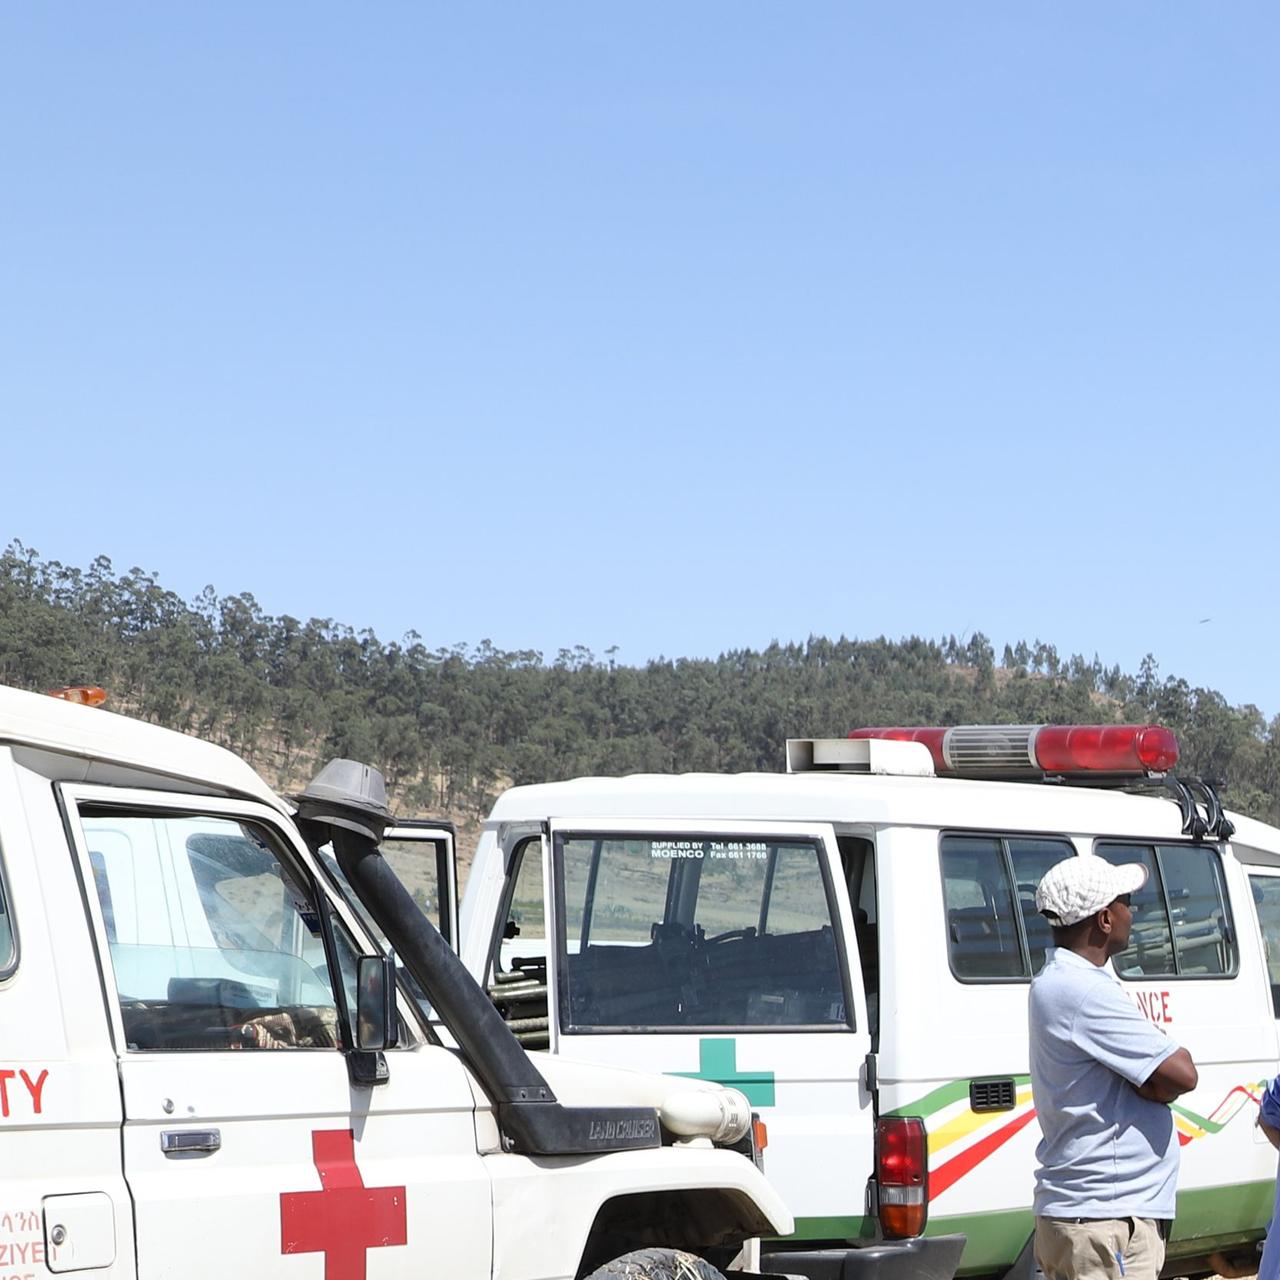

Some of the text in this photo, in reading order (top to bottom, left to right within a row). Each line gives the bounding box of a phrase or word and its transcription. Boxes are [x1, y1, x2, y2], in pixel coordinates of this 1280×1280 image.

[651, 841, 690, 849] SUPPLIED
[651, 849, 704, 858] MOENCO
[1126, 991, 1173, 1024] NCE
[589, 1120, 655, 1140] LAND CRUISER
